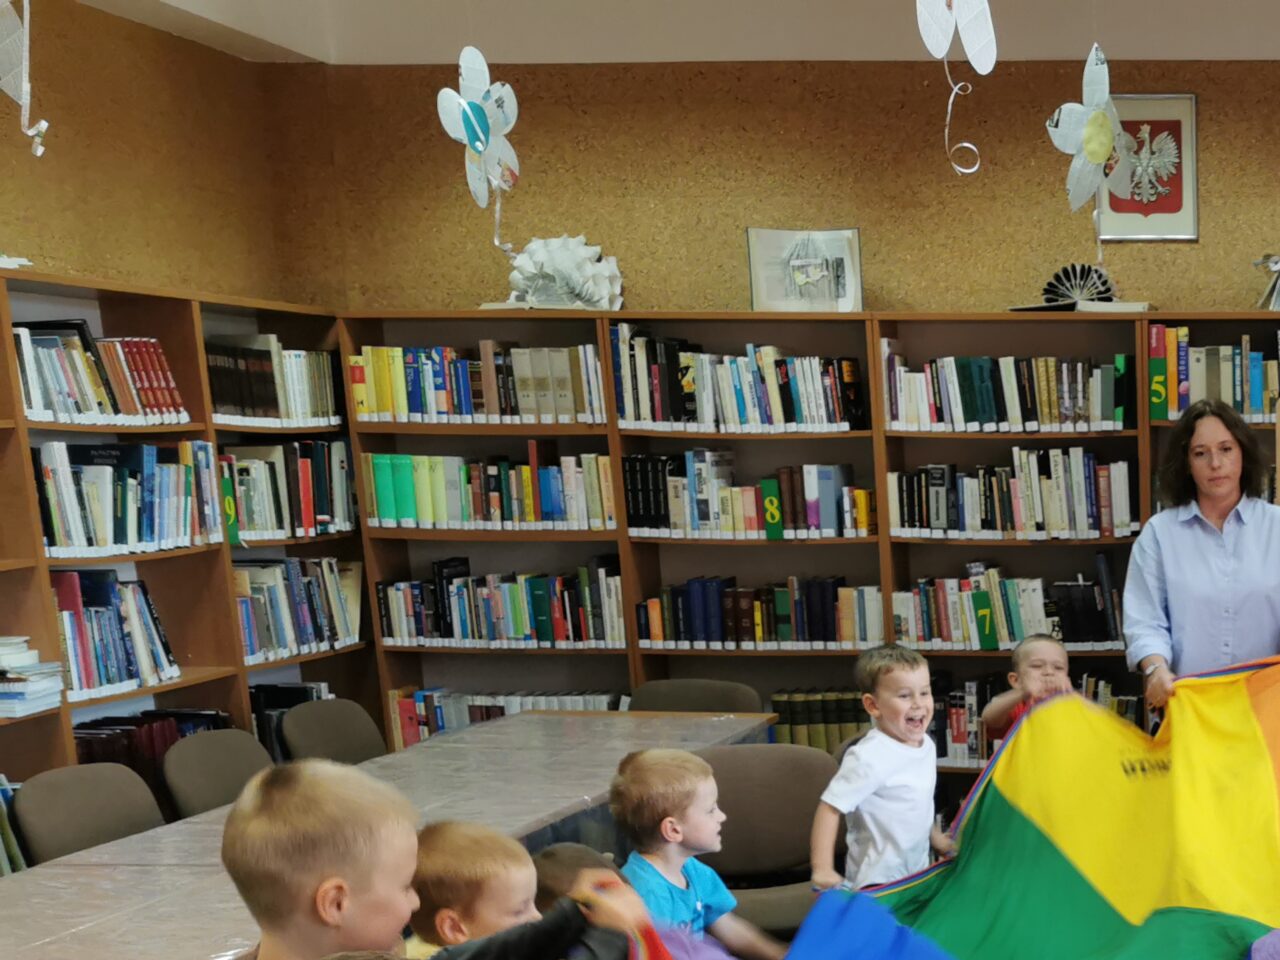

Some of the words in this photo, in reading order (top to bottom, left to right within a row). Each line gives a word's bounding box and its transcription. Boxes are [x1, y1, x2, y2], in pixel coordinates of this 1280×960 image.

[1151, 375, 1166, 403] 5
[224, 495, 236, 525] 9
[763, 496, 780, 524] 8
[977, 608, 991, 635] 7
